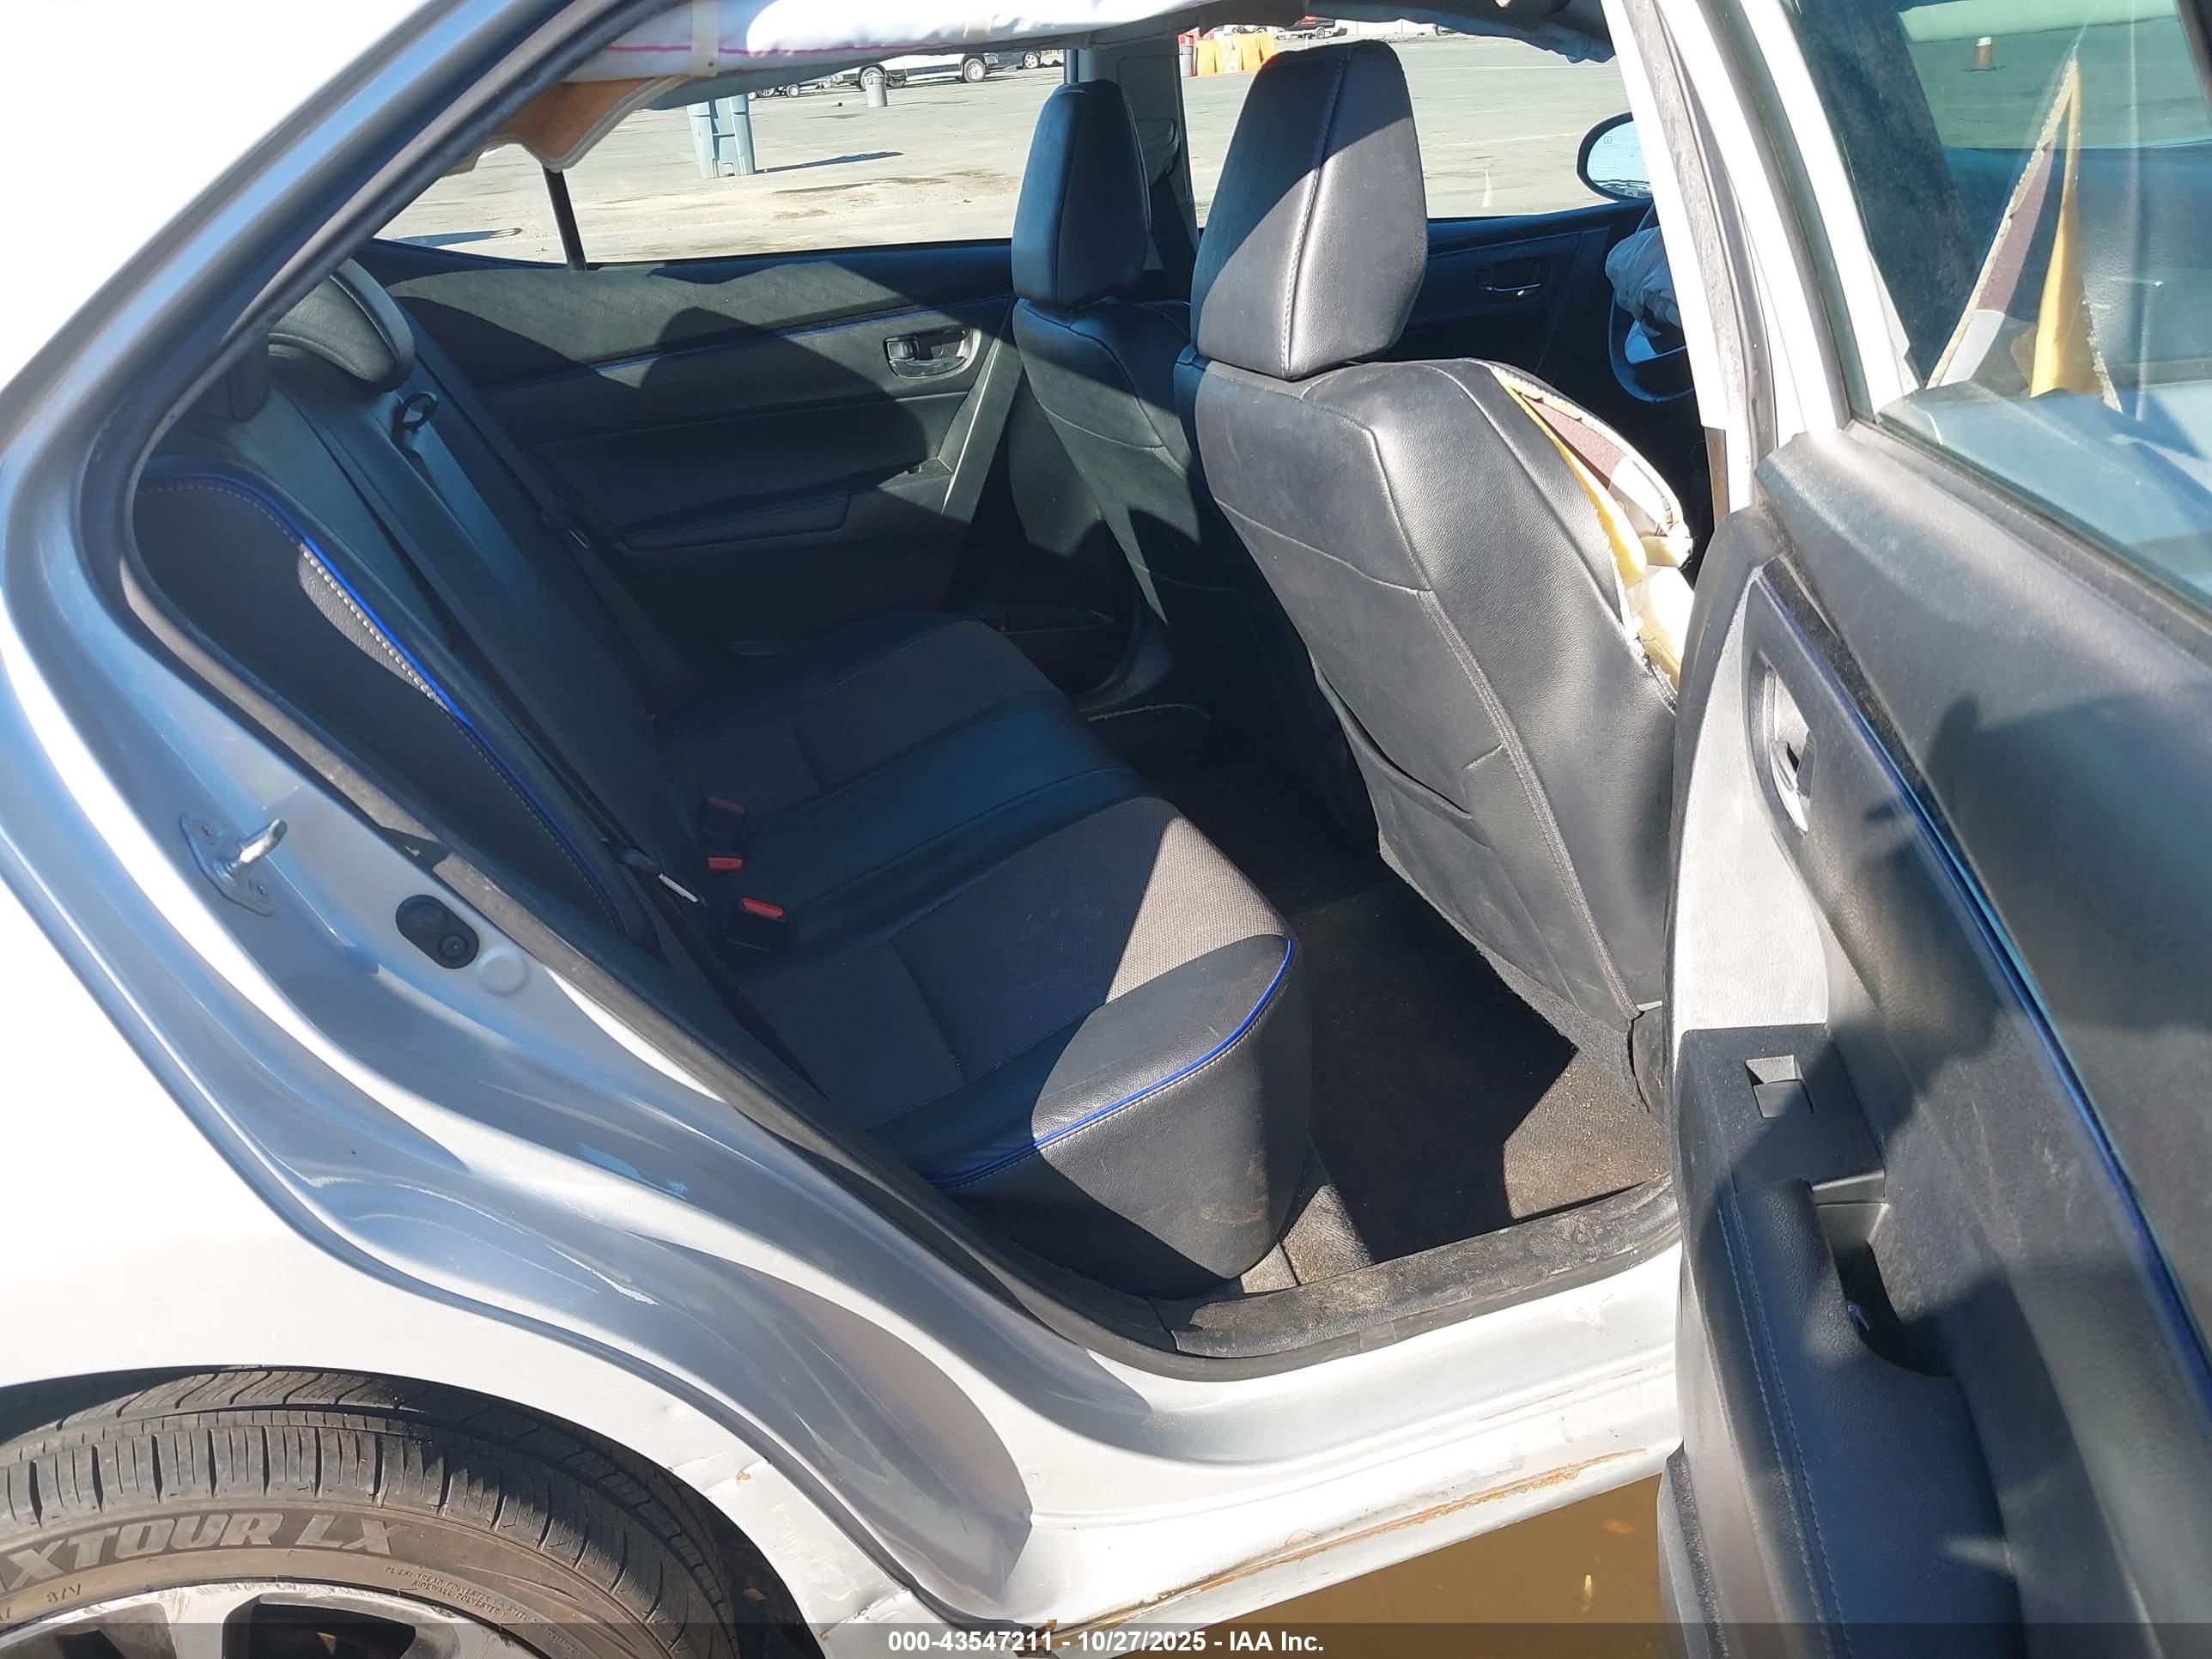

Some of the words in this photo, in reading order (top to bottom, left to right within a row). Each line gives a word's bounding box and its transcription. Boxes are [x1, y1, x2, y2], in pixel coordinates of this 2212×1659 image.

[0, 1511, 284, 1595] XTOUR
[295, 1514, 413, 1556] LX
[411, 1579, 452, 1596] SIDEWALL
[454, 1592, 500, 1614] POLYESTER
[416, 1573, 444, 1585] TREAD
[445, 1581, 491, 1602] POLYESTER
[507, 1606, 527, 1621] STEEL
